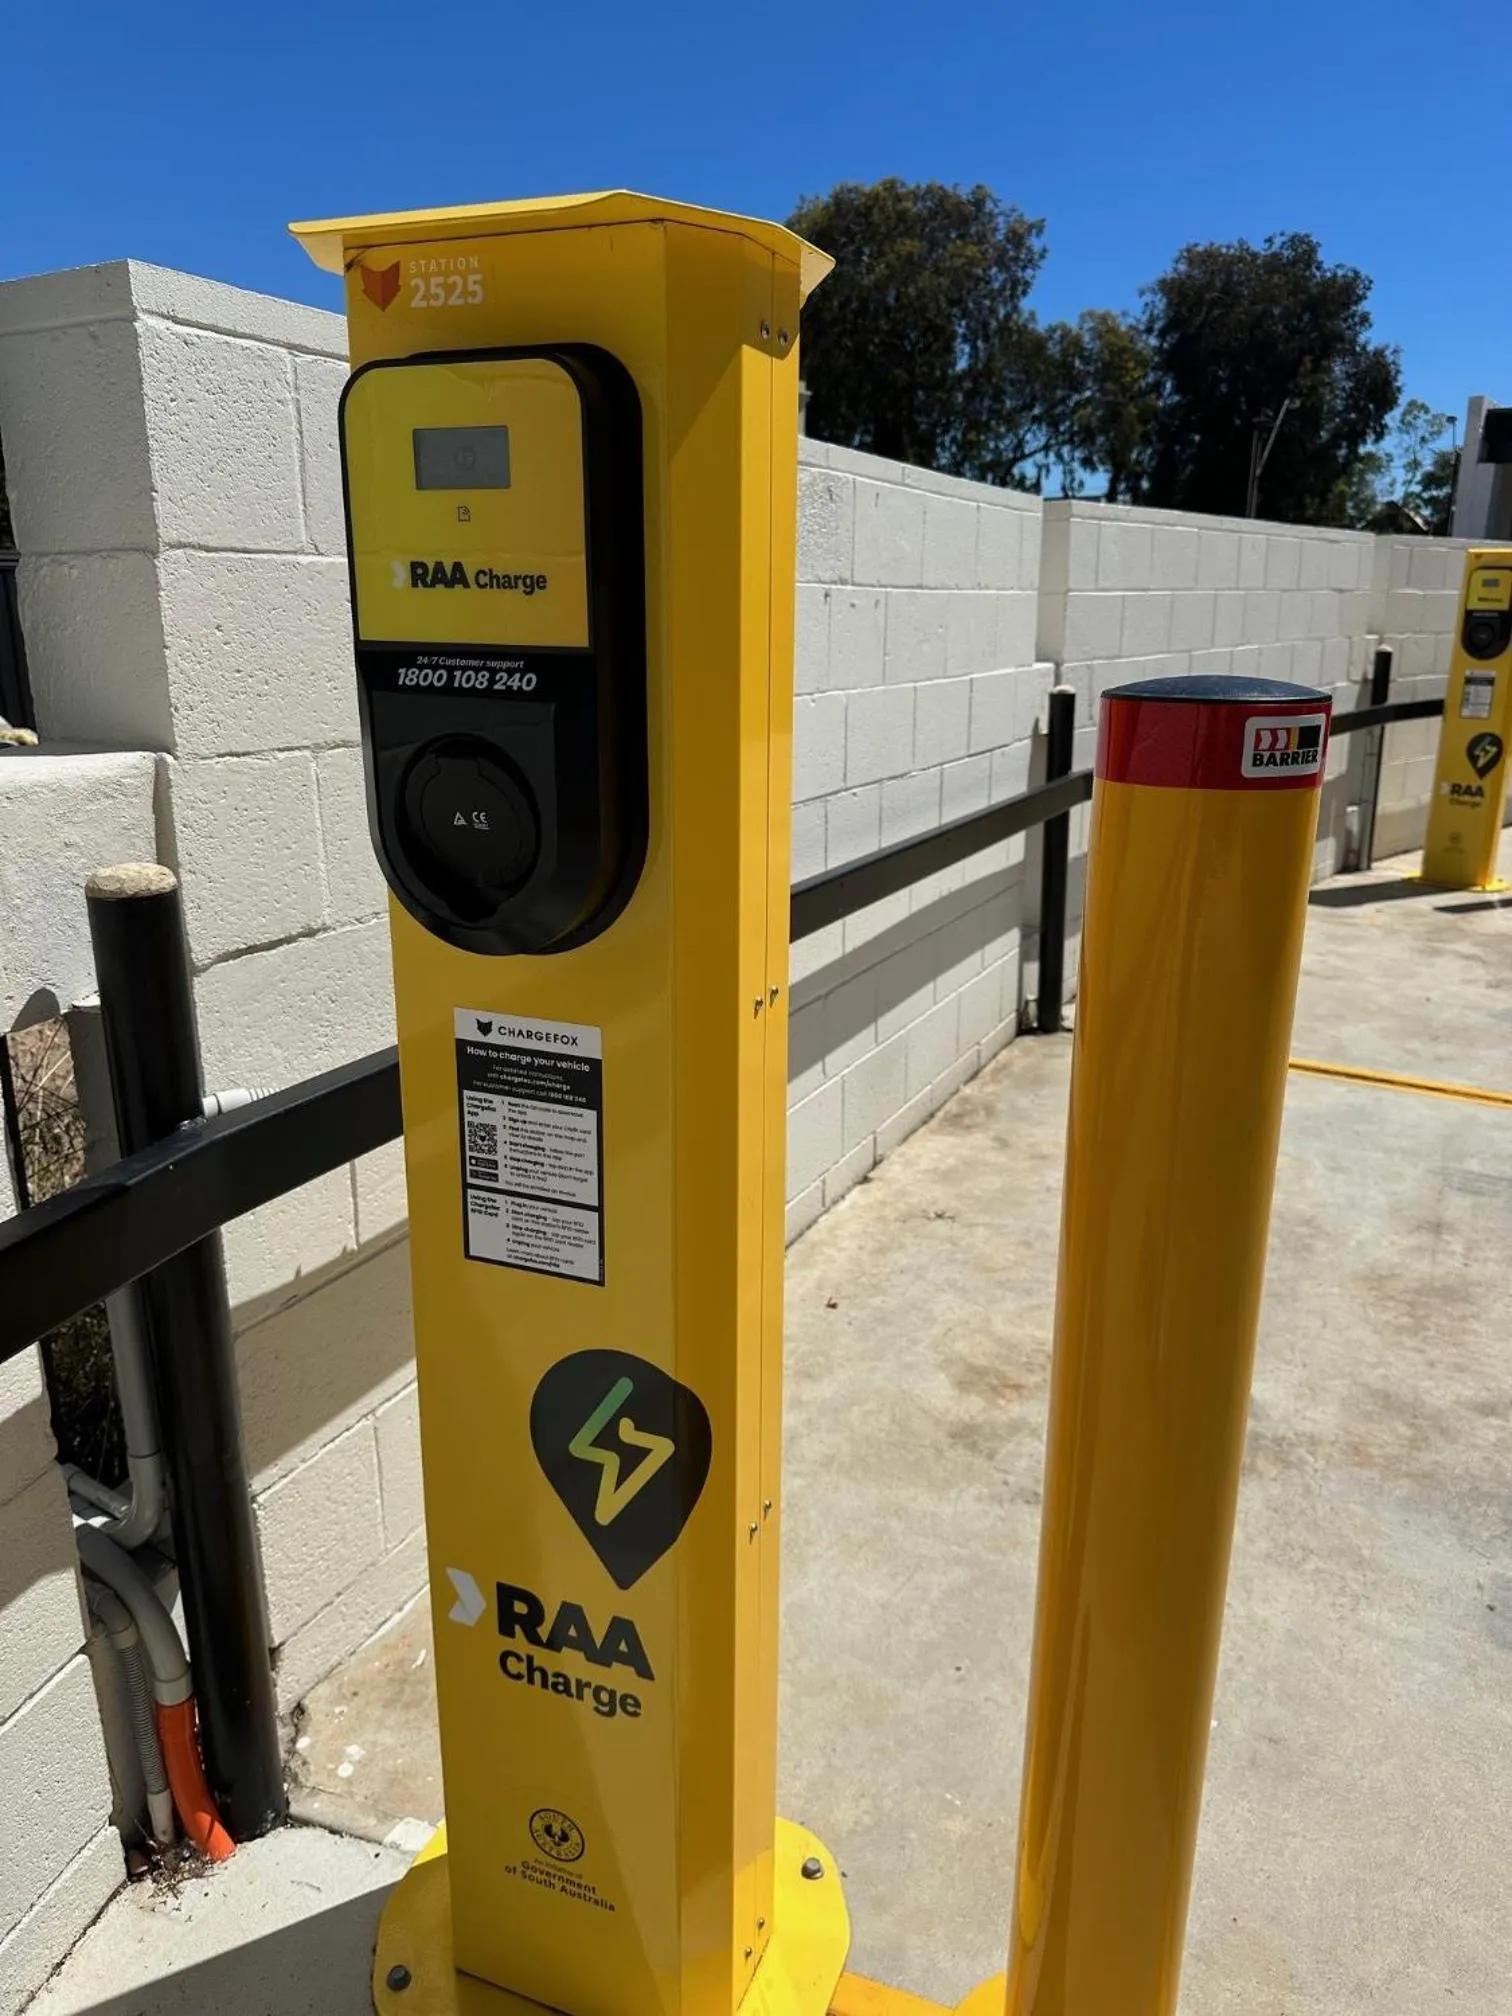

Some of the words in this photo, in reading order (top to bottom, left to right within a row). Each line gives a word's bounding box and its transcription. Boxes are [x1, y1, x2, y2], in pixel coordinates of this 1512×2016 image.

[409, 256, 479, 274] STATION
[409, 274, 484, 308] 2525
[410, 560, 471, 590] RAA
[475, 568, 548, 595] Charge
[438, 656, 485, 667] Customer
[486, 659, 525, 670] support
[397, 667, 448, 687] 1800
[452, 669, 490, 690] 108
[492, 672, 537, 692] 240
[1251, 749, 1318, 768] BARRIER
[1450, 782, 1485, 798] RAA
[498, 1026, 579, 1047] CHARGEFOX
[466, 1046, 487, 1057] How
[488, 1050, 498, 1059] to
[499, 1050, 532, 1065] charge
[533, 1056, 555, 1068] your
[556, 1058, 591, 1072] vehicle
[495, 1581, 656, 1682] RAA
[498, 1650, 642, 1718] Charge
[504, 1864, 517, 1875] of
[520, 1870, 556, 1890] South
[559, 1884, 616, 1913] Australia
[520, 1860, 597, 1895] Government
